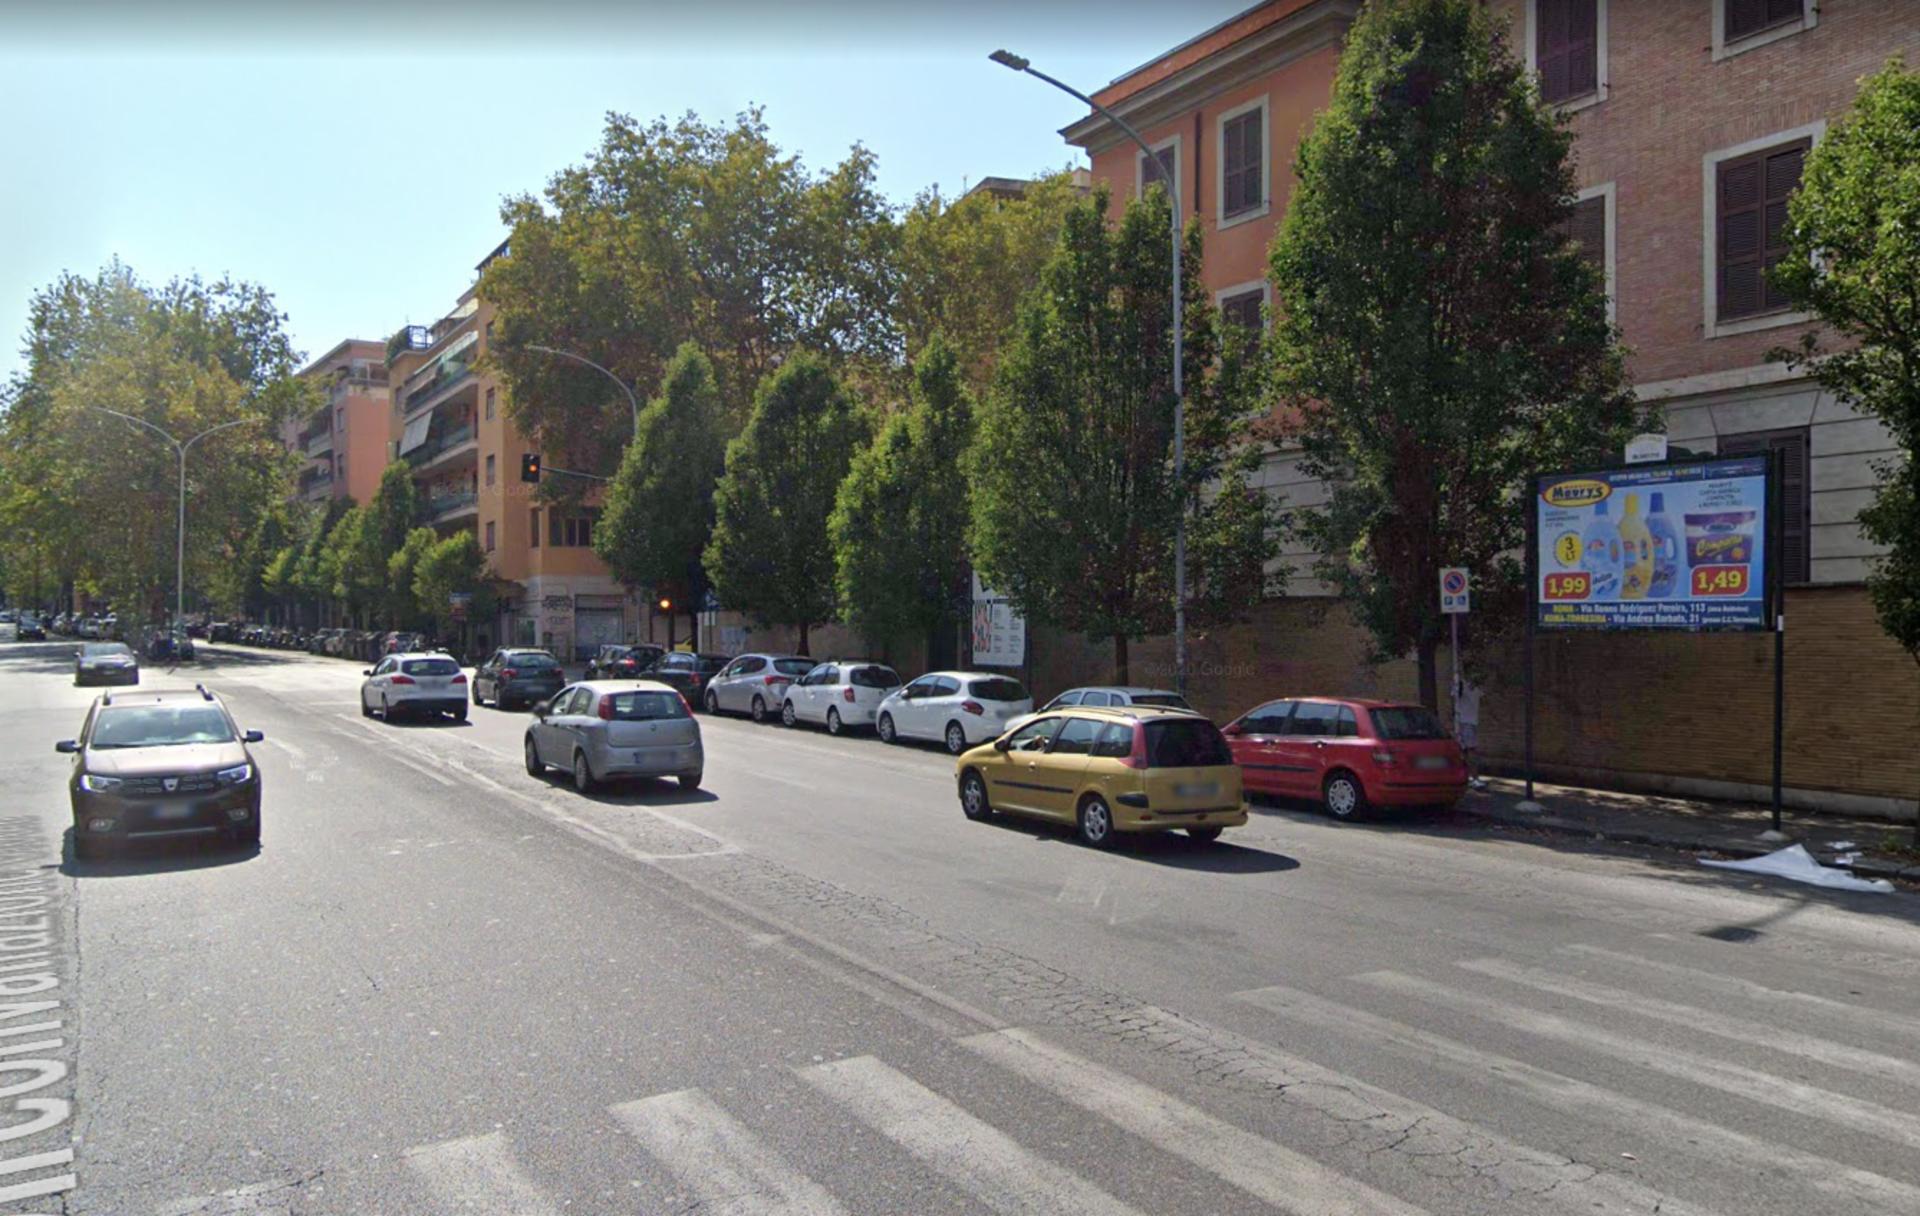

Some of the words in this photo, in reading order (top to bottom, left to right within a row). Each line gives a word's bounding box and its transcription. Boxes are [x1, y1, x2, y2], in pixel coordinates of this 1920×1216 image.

[1564, 537, 1574, 550] 3
[1549, 577, 1586, 597] 1,99
[1697, 570, 1741, 592] 1,49
[1581, 604, 1592, 612] Via
[1613, 614, 1625, 623] Via
